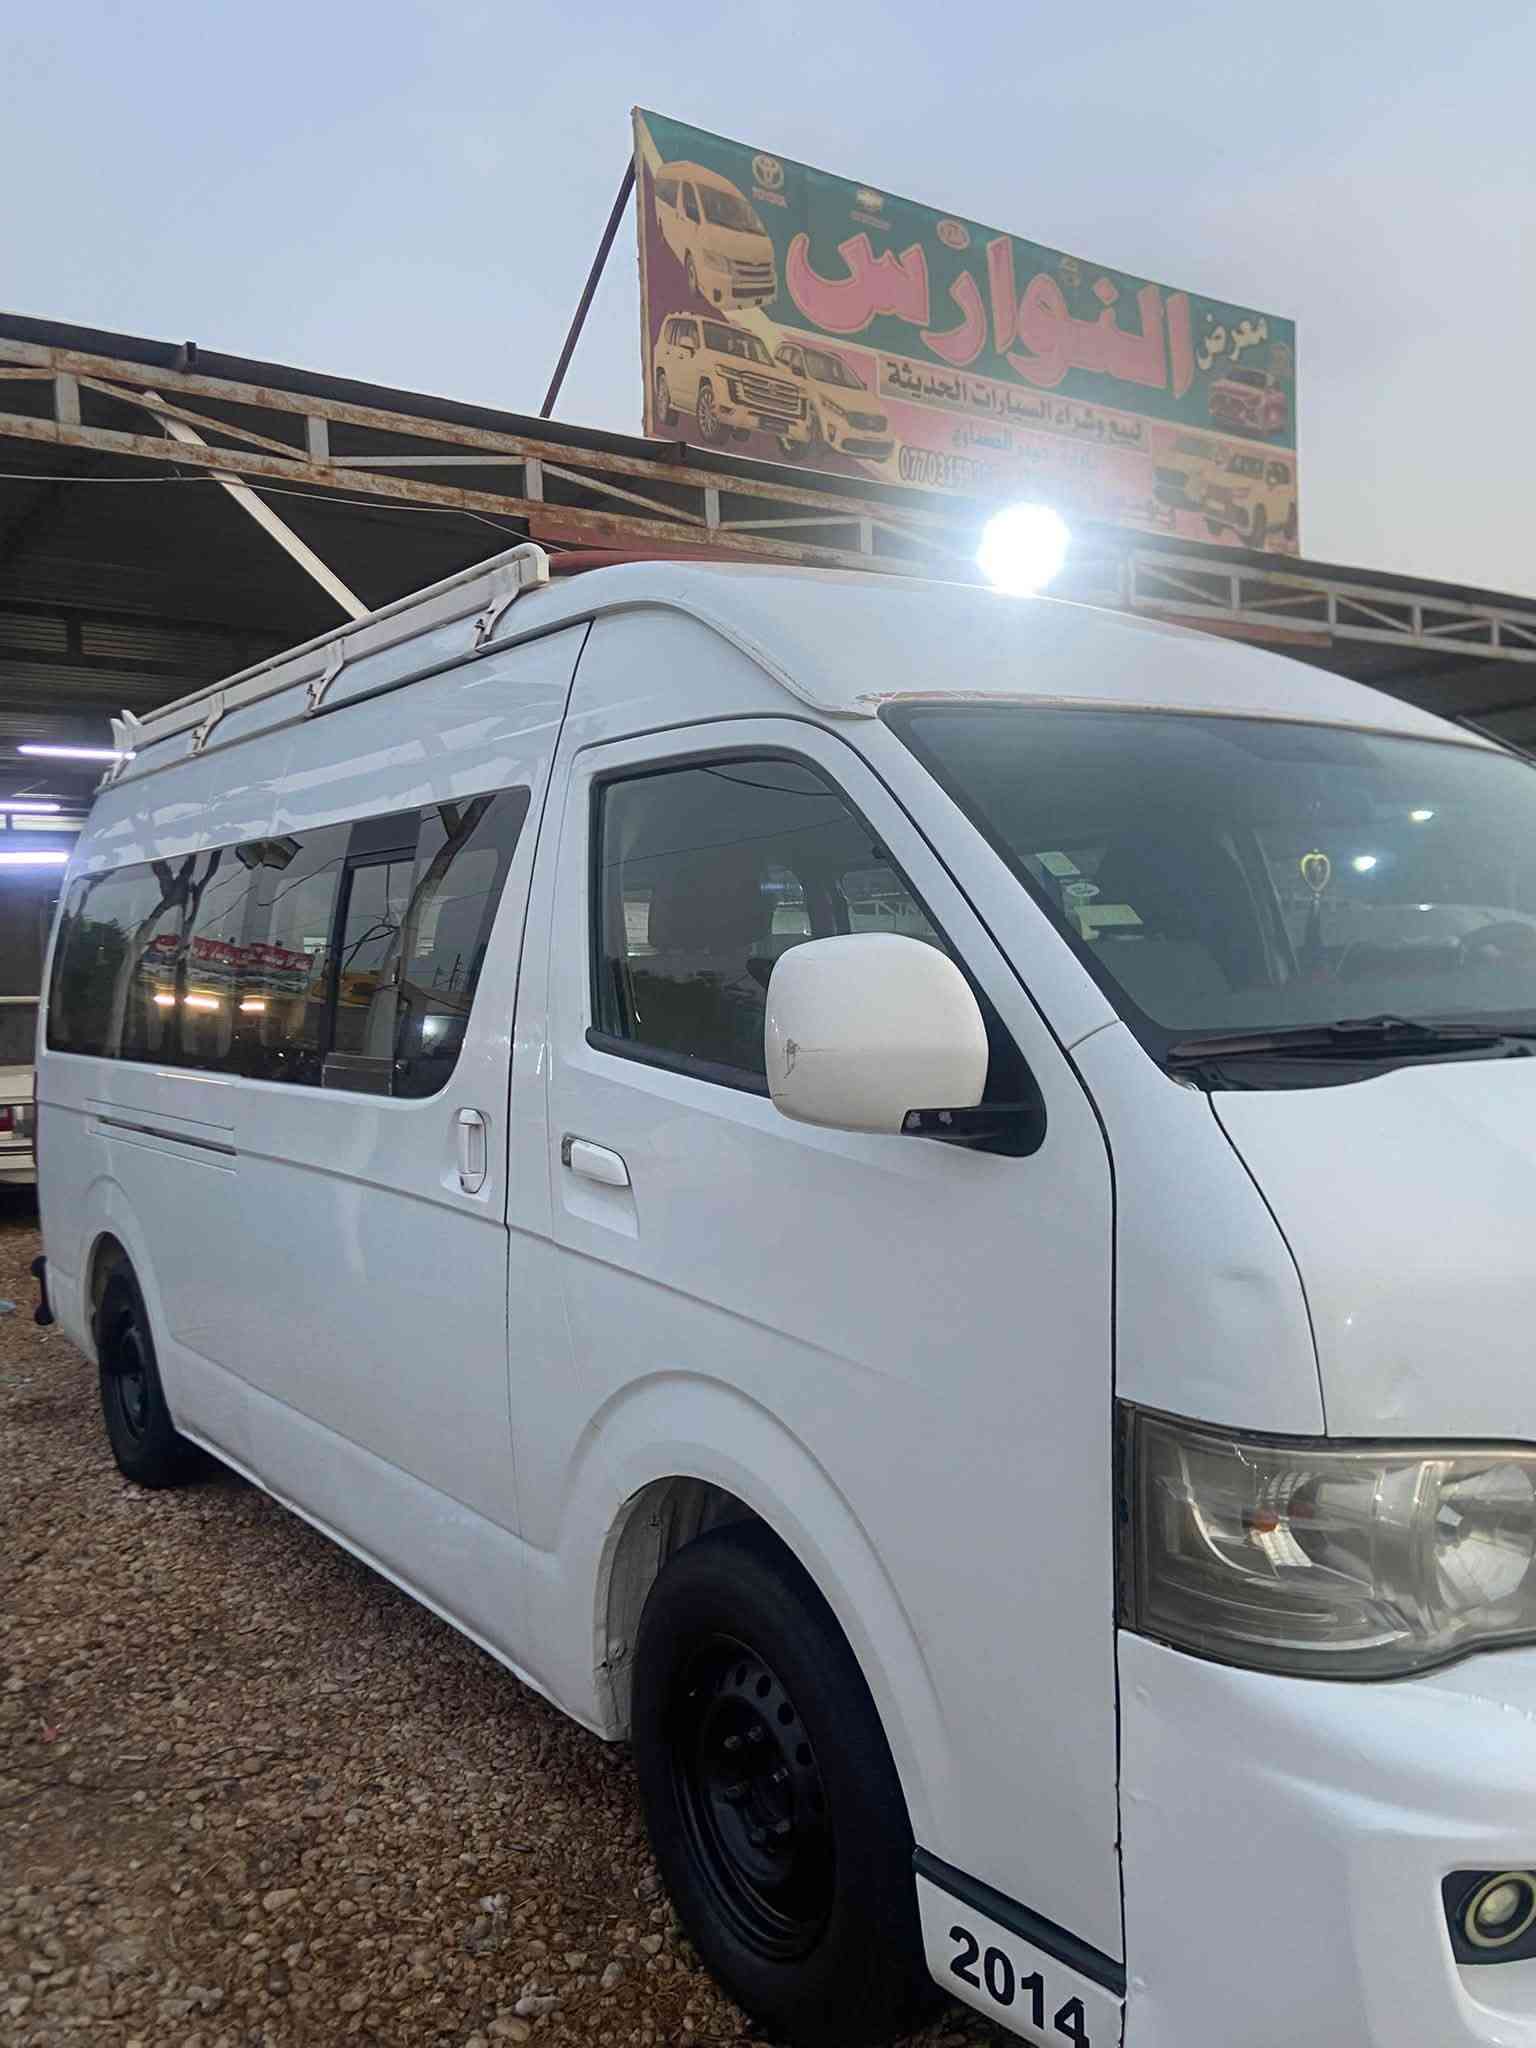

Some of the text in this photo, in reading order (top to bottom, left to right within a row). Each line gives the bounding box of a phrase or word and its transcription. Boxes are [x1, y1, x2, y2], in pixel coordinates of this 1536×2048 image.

[785, 230, 1267, 400] معرض النوارس
[886, 361, 967, 402] الحديثة
[972, 383, 1052, 422] السيارات
[950, 1926, 1090, 2048] 2014
